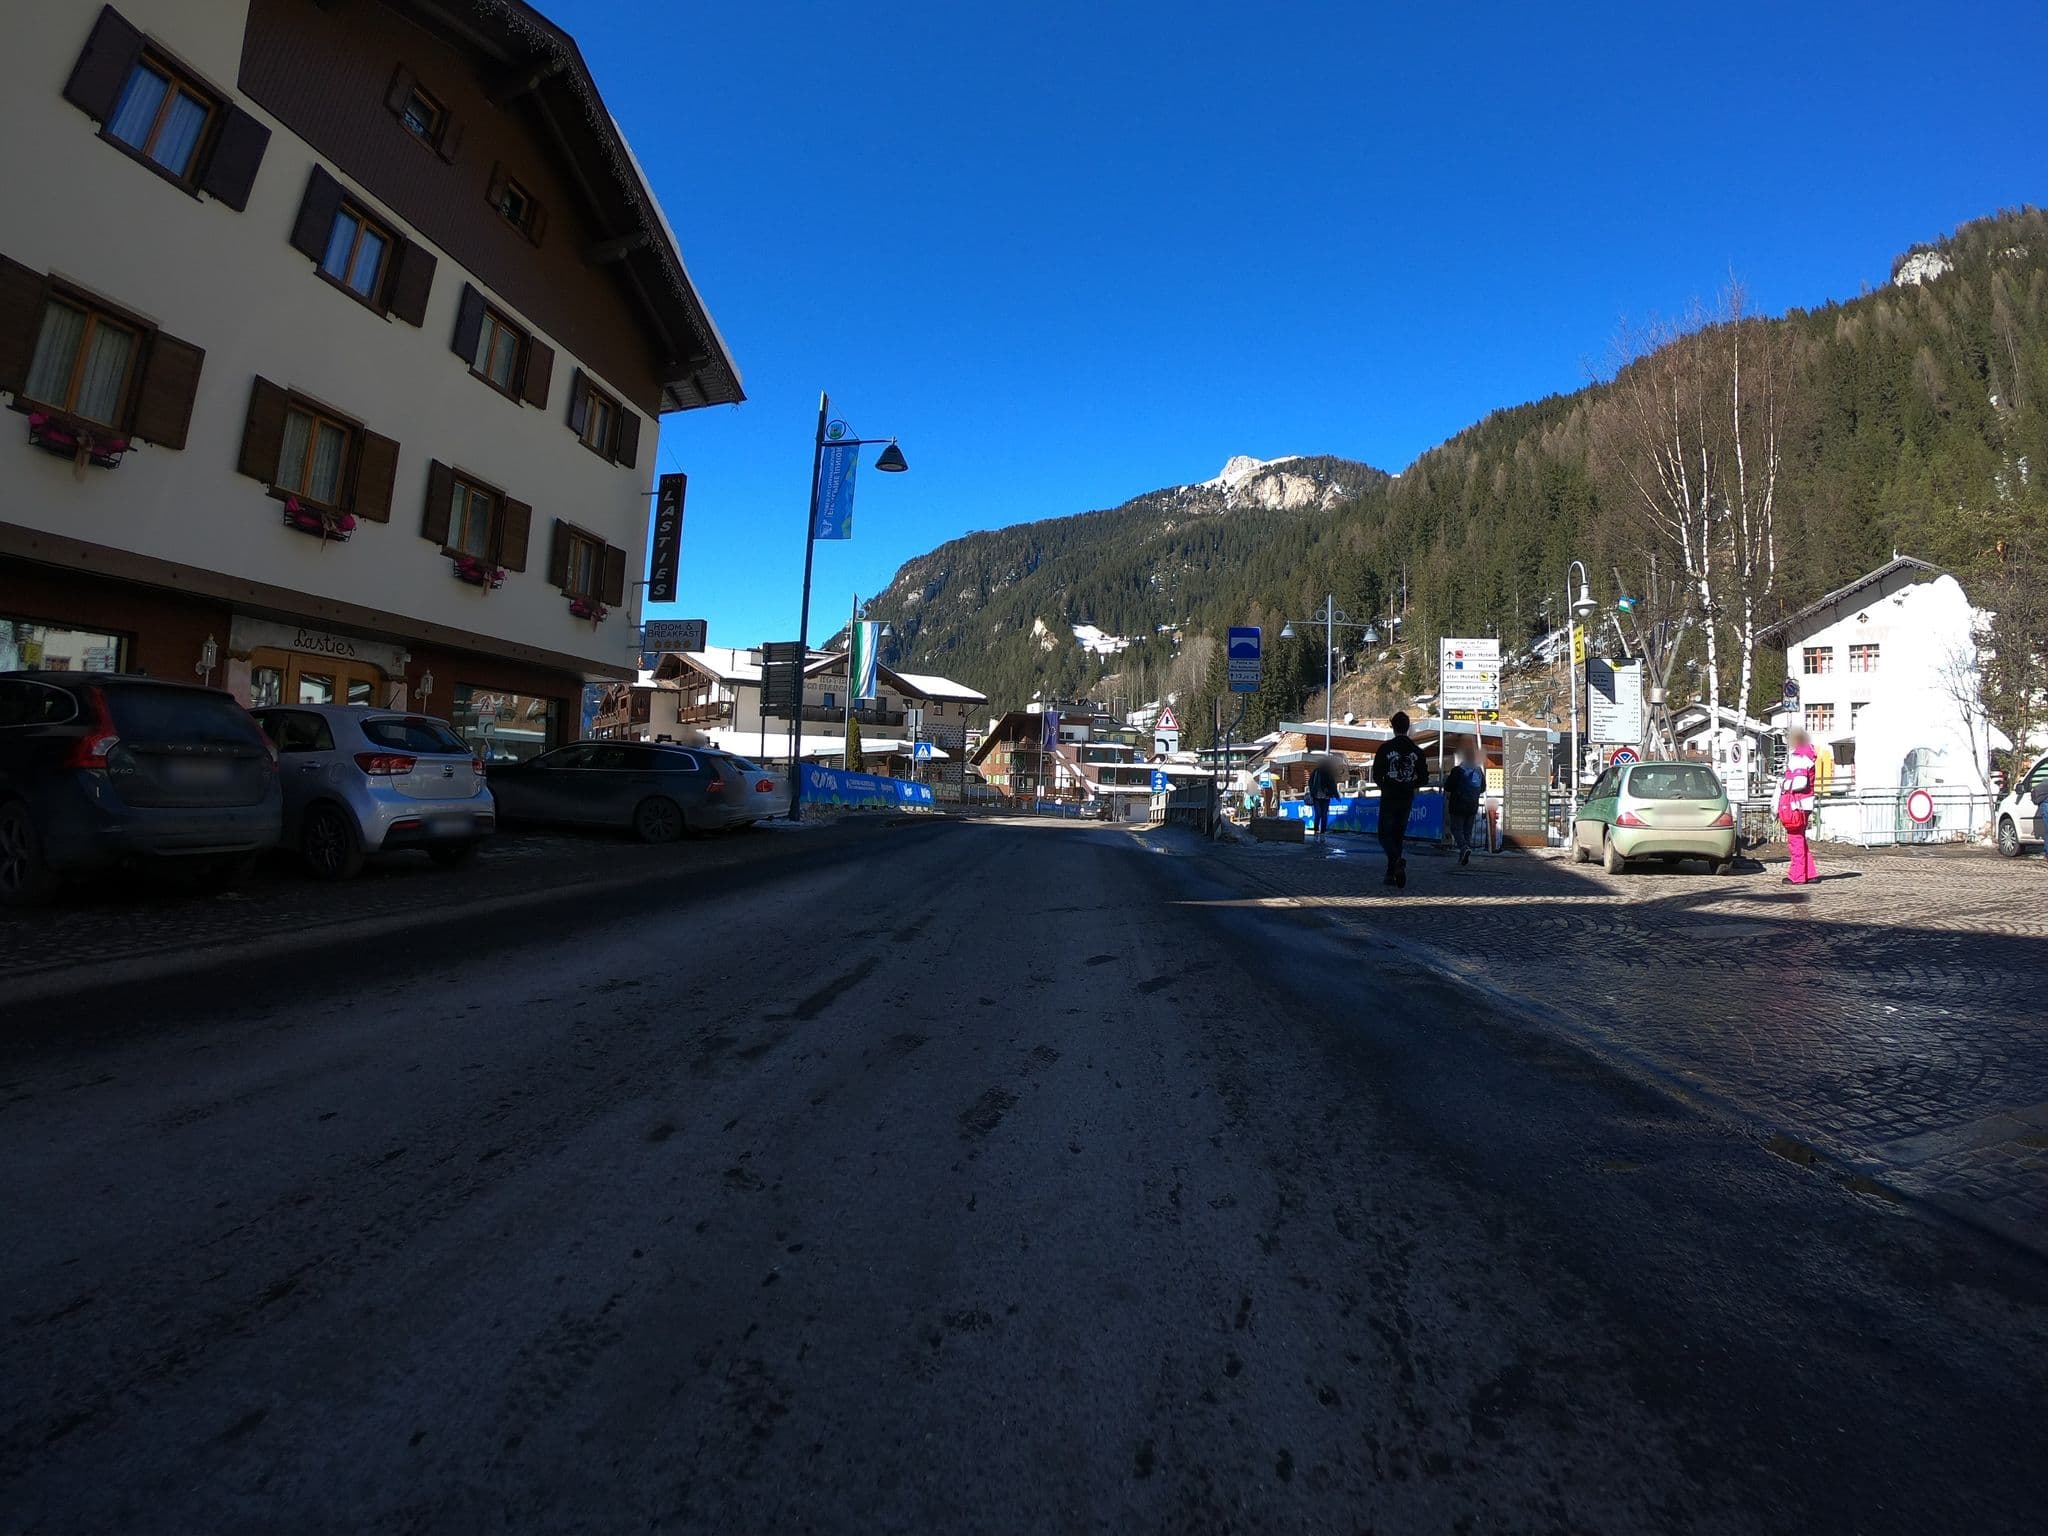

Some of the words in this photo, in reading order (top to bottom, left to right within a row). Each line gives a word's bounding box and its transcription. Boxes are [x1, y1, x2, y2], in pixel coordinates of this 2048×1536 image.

[654, 490, 675, 596] LASTIES
[647, 629, 700, 638] BREAKFAST
[654, 623, 682, 631] ROOM
[687, 622, 693, 630] &
[294, 629, 355, 657] Lasties
